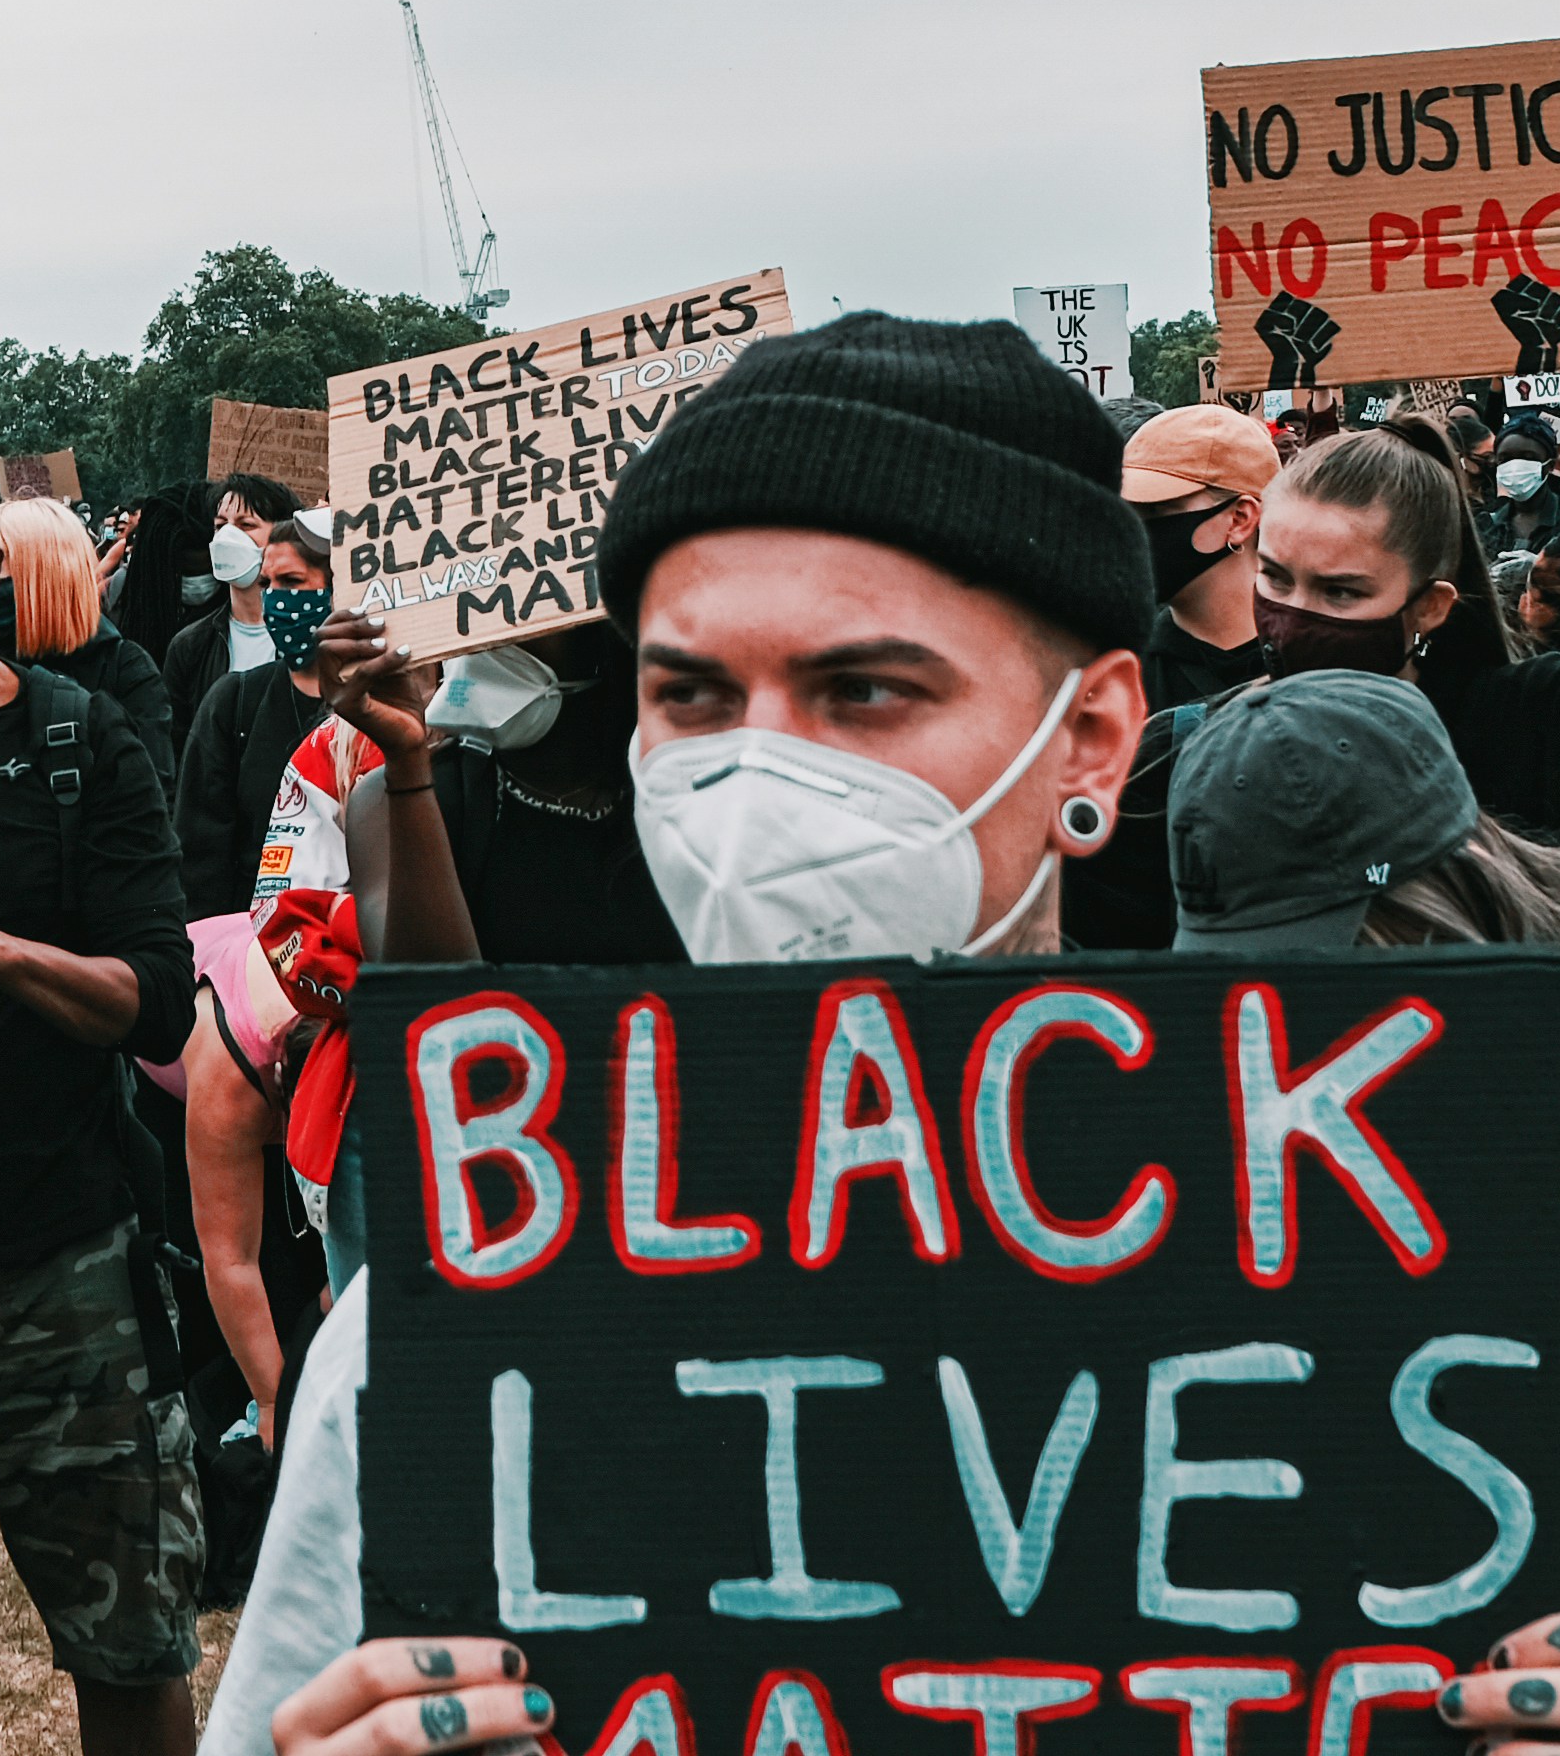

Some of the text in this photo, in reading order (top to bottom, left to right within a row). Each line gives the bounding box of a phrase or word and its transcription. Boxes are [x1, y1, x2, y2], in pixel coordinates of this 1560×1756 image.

[1210, 104, 1299, 189] NO
[1040, 288, 1096, 311] THE
[1218, 217, 1326, 299] NO
[363, 284, 759, 423] BLACK LIVES
[1057, 314, 1089, 339] UK
[1057, 340, 1089, 365] IS
[383, 375, 601, 461] MATTER
[331, 439, 636, 547] MATTERED
[368, 430, 544, 498] BLACK
[350, 510, 526, 585] BLACK
[355, 525, 601, 615] ALWAYS AND
[405, 976, 1446, 1290] BLACK
[488, 1333, 1543, 1634] LIVES
